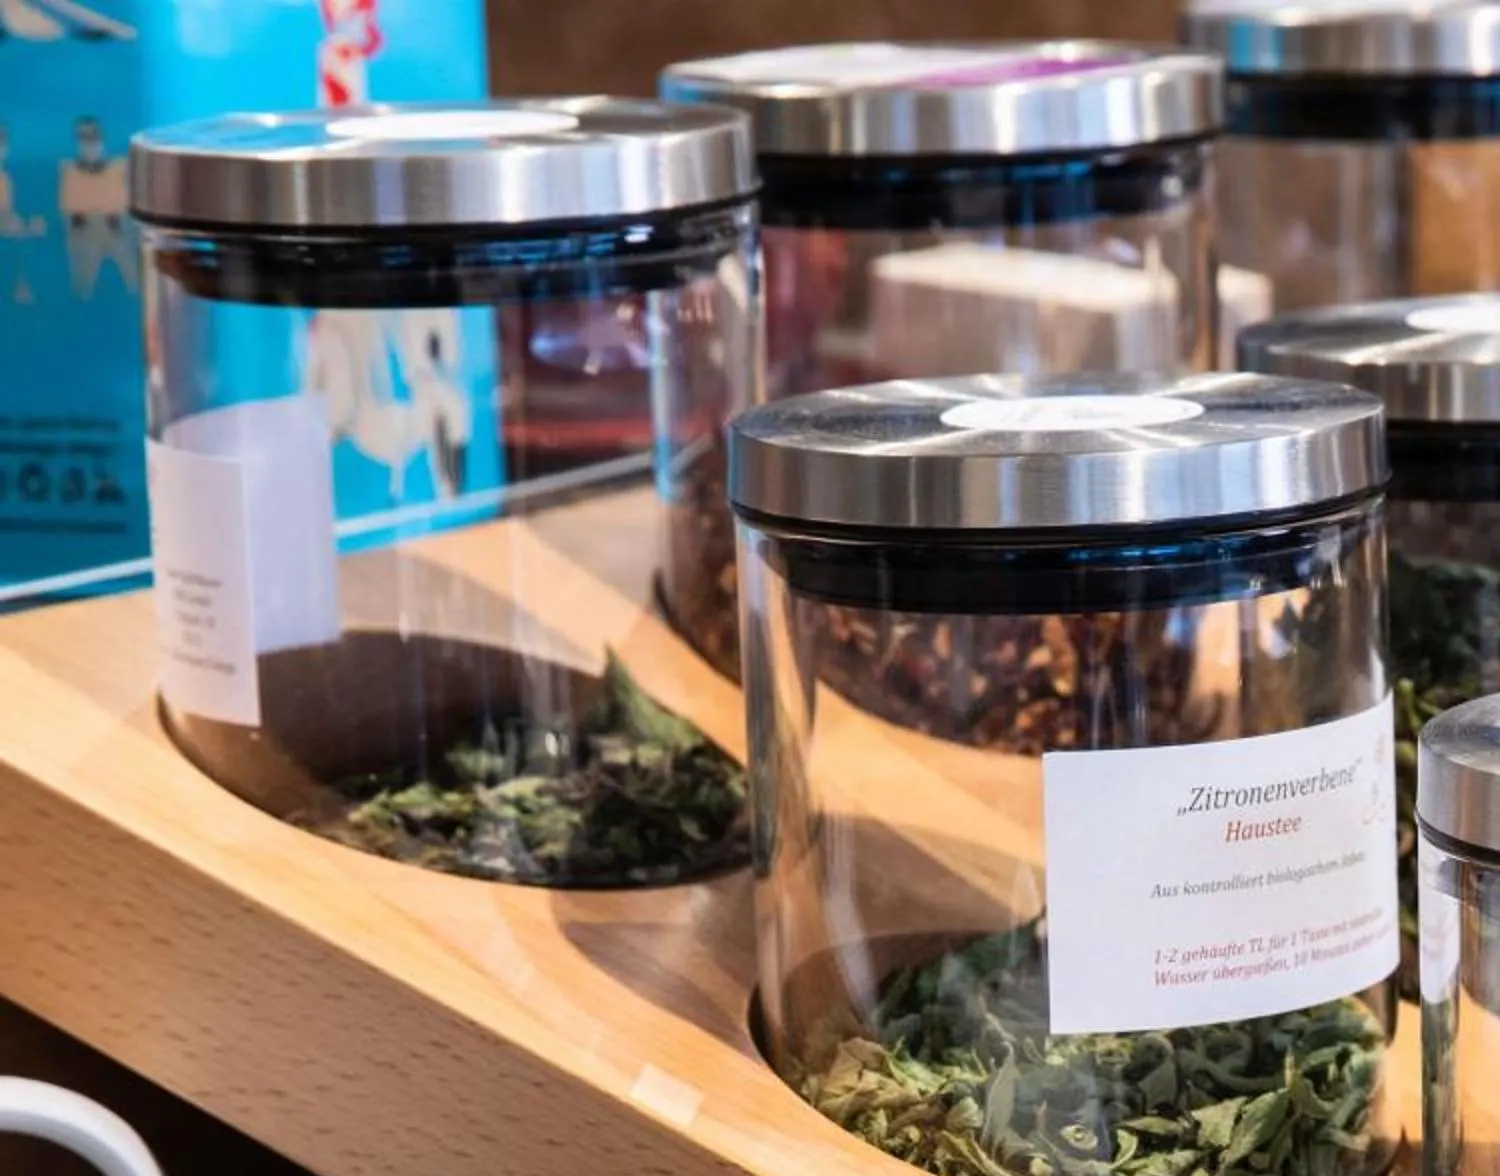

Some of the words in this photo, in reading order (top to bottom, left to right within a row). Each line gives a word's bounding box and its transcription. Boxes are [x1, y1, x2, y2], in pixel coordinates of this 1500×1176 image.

[1225, 816, 1302, 843] Haustee
[1151, 883, 1179, 899] Aus
[1183, 874, 1264, 896] kontrolliert
[1154, 949, 1179, 966] 1-2
[1247, 937, 1265, 954] TL
[1265, 935, 1288, 955] für
[1154, 968, 1208, 987] Wasser
